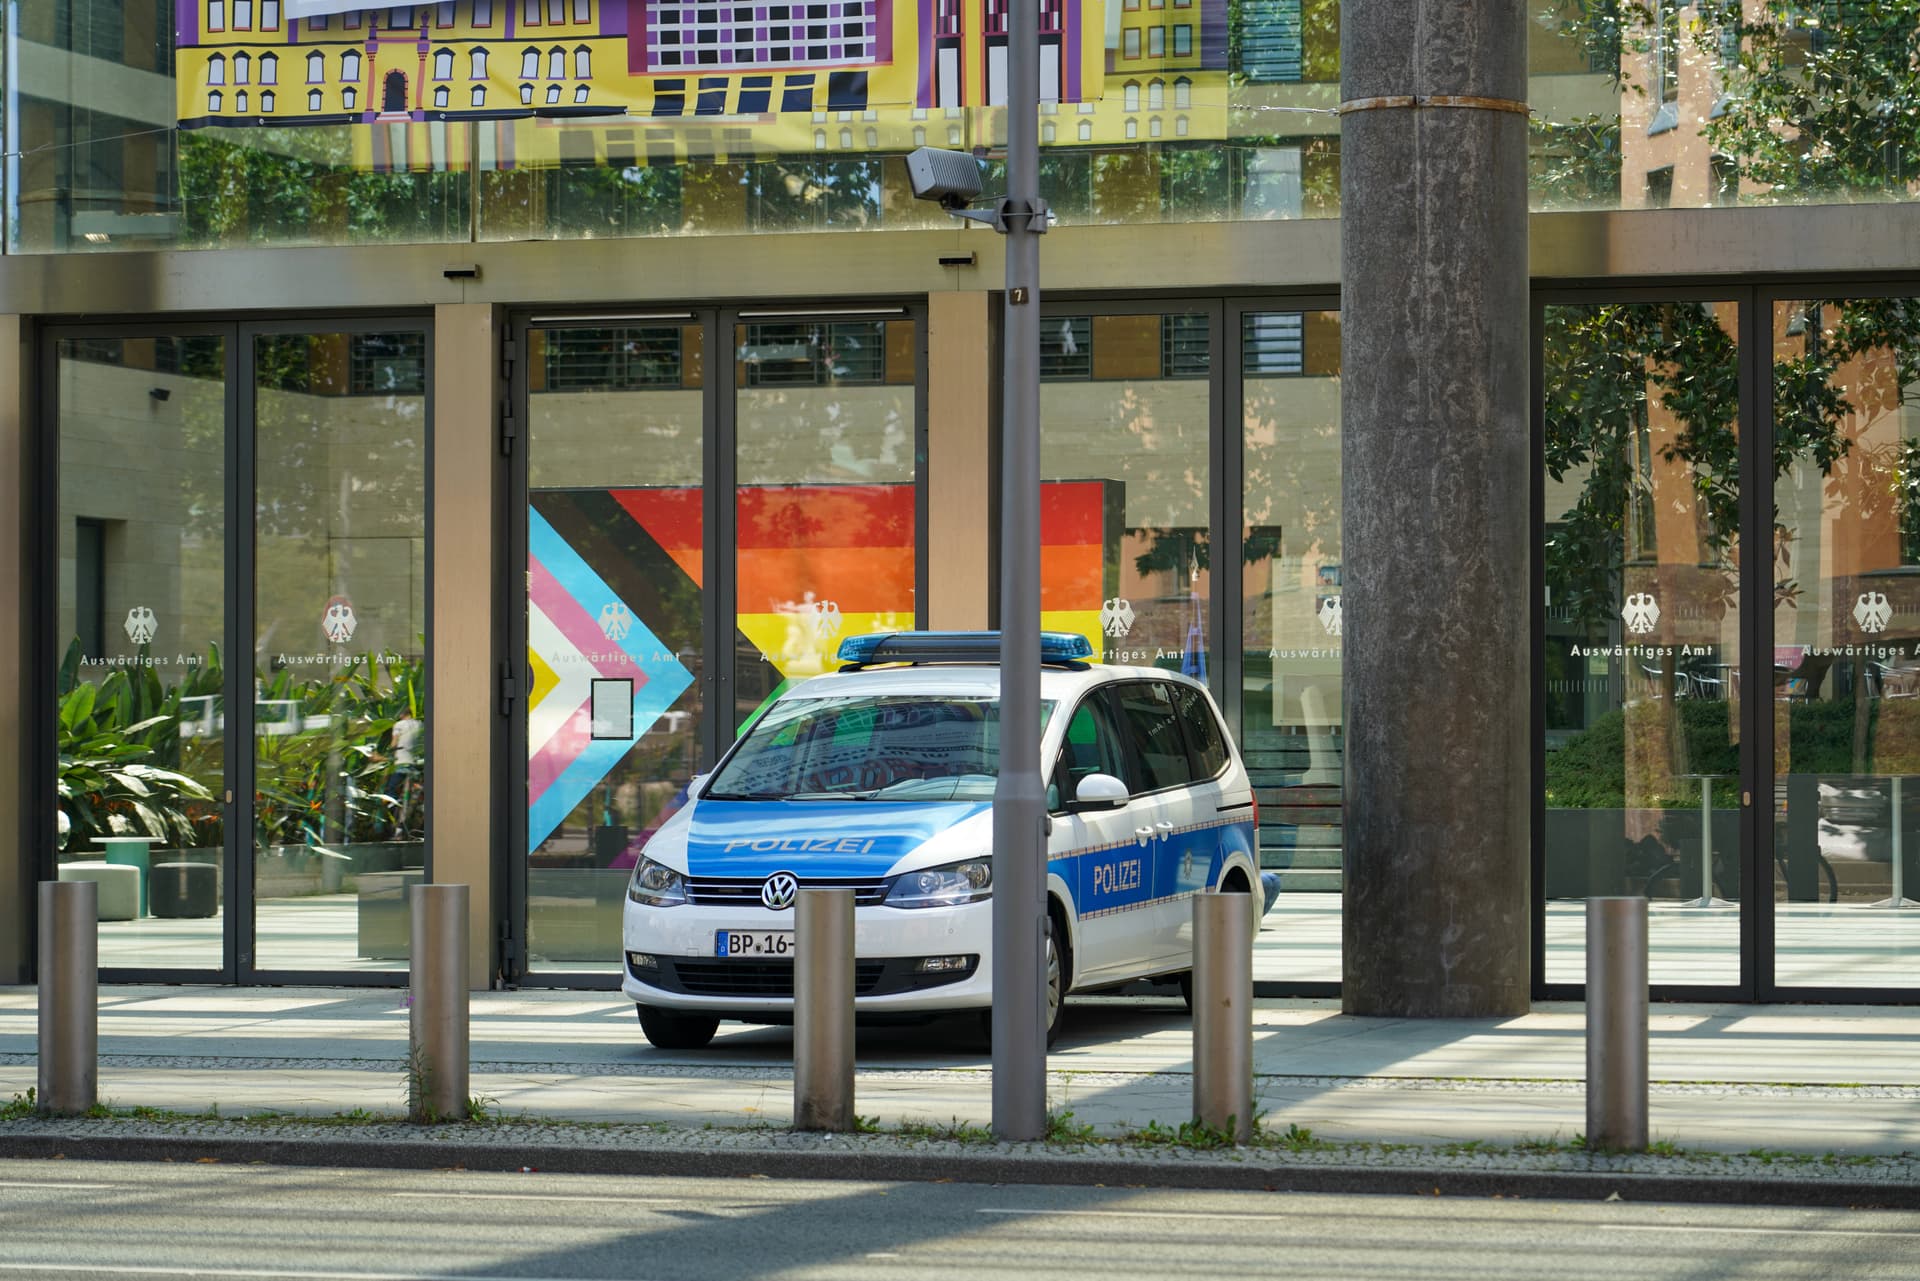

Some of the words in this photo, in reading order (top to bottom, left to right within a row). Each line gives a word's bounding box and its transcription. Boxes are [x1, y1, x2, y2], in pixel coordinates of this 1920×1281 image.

[1014, 289, 1022, 302] 7
[552, 651, 644, 665] Auswärtiges
[652, 651, 680, 663] Amt
[1092, 648, 1147, 663] ärtiges
[1155, 648, 1185, 660] Amt
[1269, 647, 1341, 659] Auswärti
[1570, 643, 1673, 659] Auswärtiges
[1681, 644, 1713, 656] Amt
[1801, 643, 1905, 659] Auswärtiges
[80, 653, 168, 668] Auswärtiges
[176, 653, 203, 665] Amt
[278, 653, 367, 667] Auswärtiges
[376, 653, 403, 665] Amt
[723, 837, 876, 854] POLIZEI
[1093, 858, 1141, 896] POLIZEI
